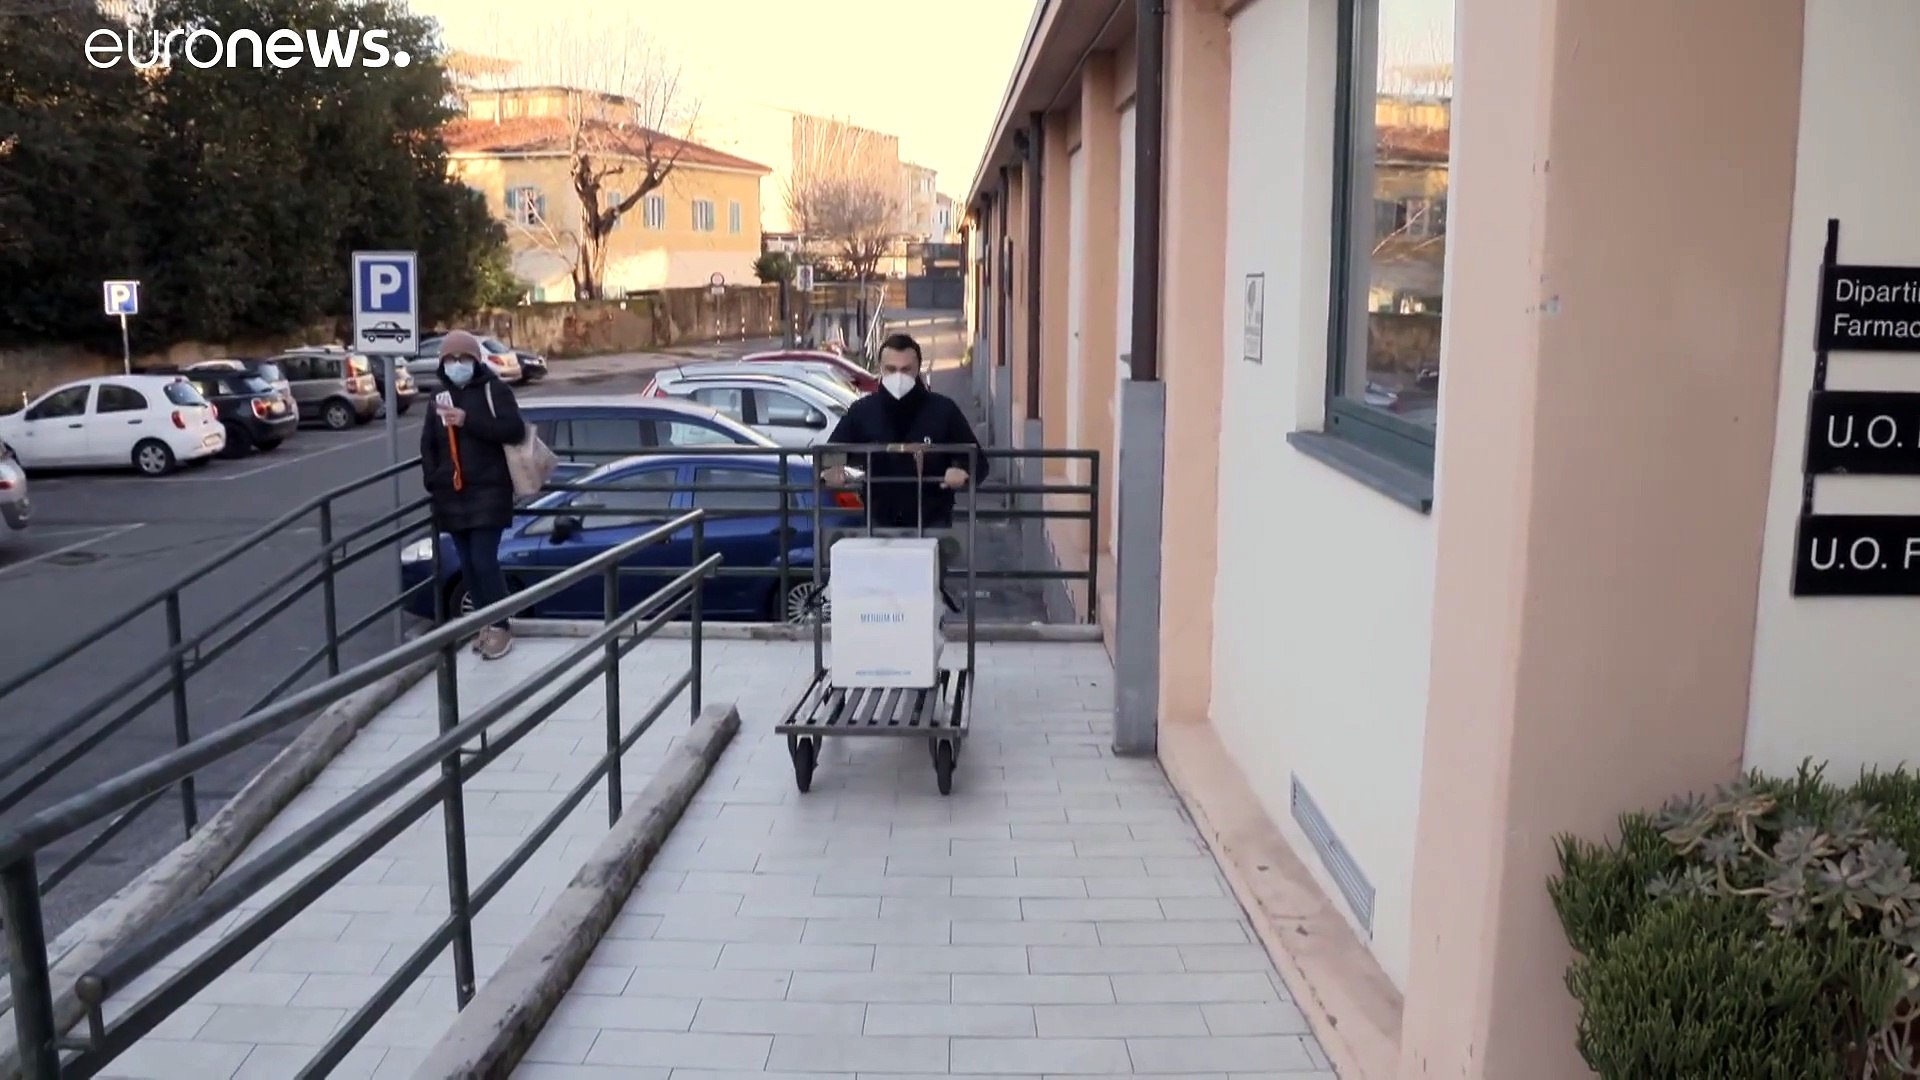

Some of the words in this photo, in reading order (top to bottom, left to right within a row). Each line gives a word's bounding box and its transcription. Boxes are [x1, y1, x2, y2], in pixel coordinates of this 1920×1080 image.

[111, 284, 131, 311] P
[370, 264, 402, 309] P
[1836, 278, 1920, 307] Diparti
[1828, 414, 1903, 448] U.O.
[1811, 537, 1887, 570] U.O.
